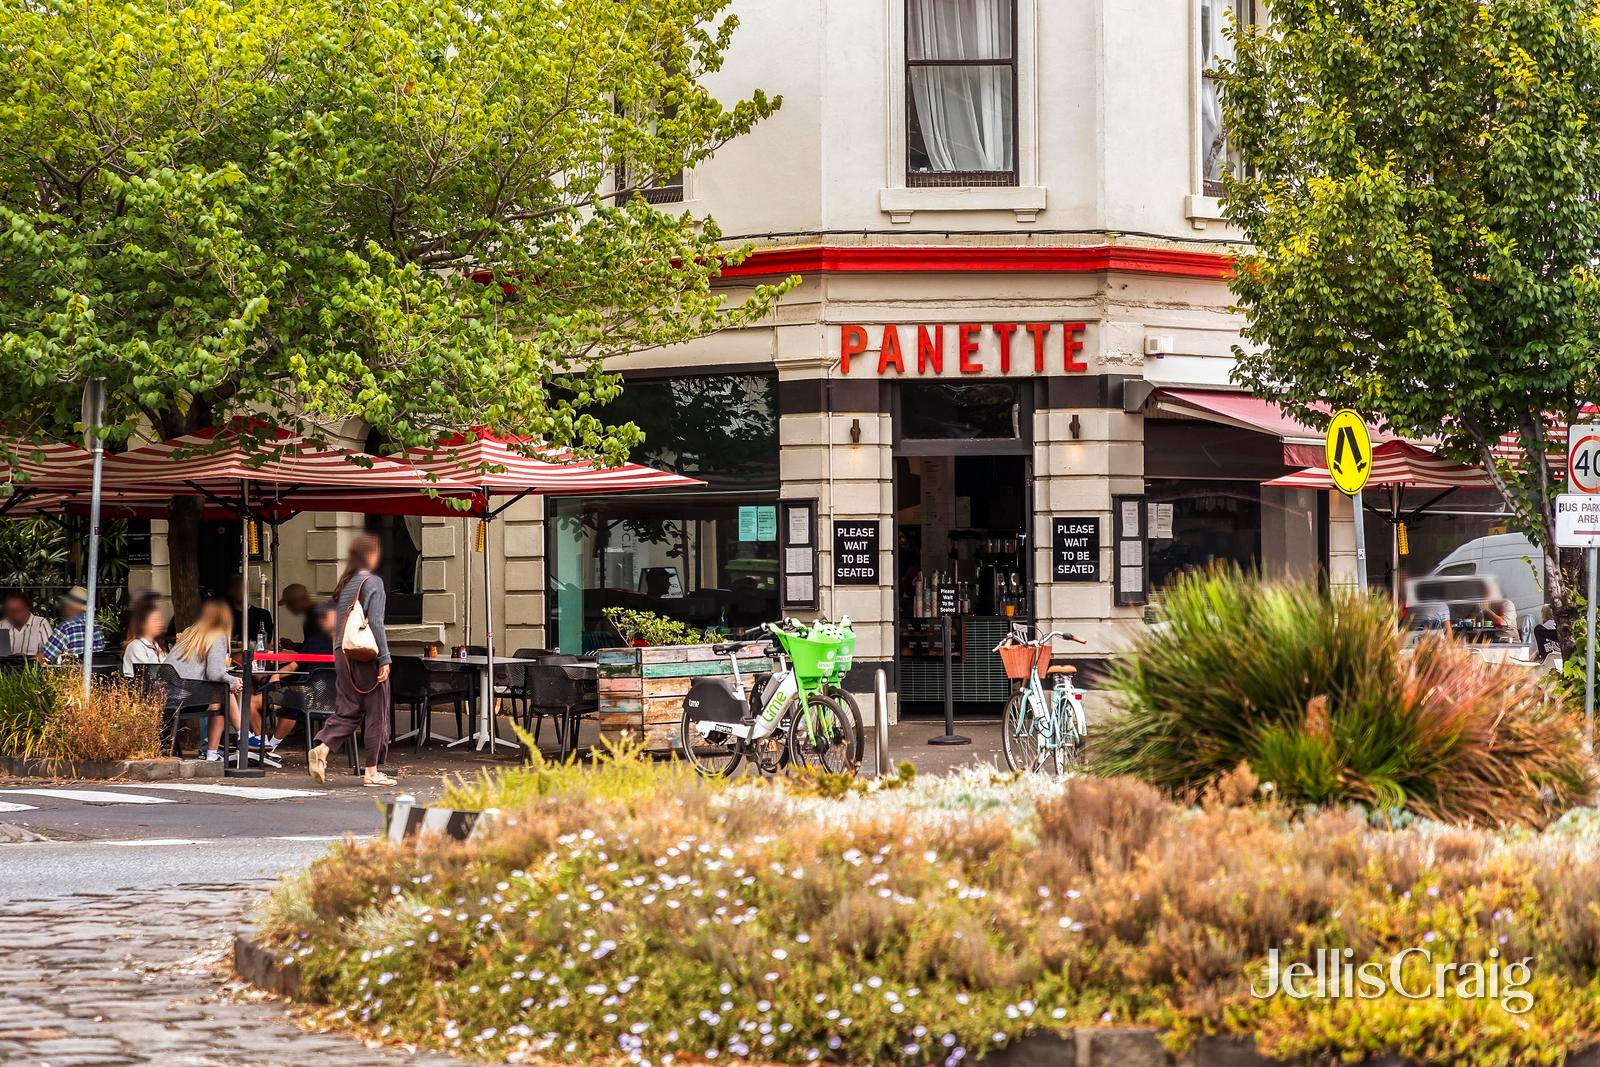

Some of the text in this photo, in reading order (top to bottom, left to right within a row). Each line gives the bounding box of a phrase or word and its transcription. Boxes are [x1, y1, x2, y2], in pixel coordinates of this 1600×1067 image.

[840, 322, 1088, 375] PANETTE
[1559, 502, 1578, 512] BUS
[1578, 514, 1599, 524] AREA
[837, 528, 875, 537] PLEASE
[1057, 525, 1095, 534] PLEASE
[843, 541, 868, 550] WAIT
[1063, 538, 1088, 547] WAIT
[841, 555, 870, 564] TO BE
[1061, 552, 1090, 561] TO BE
[837, 568, 875, 577] SEATED
[1057, 565, 1095, 574] SEATED
